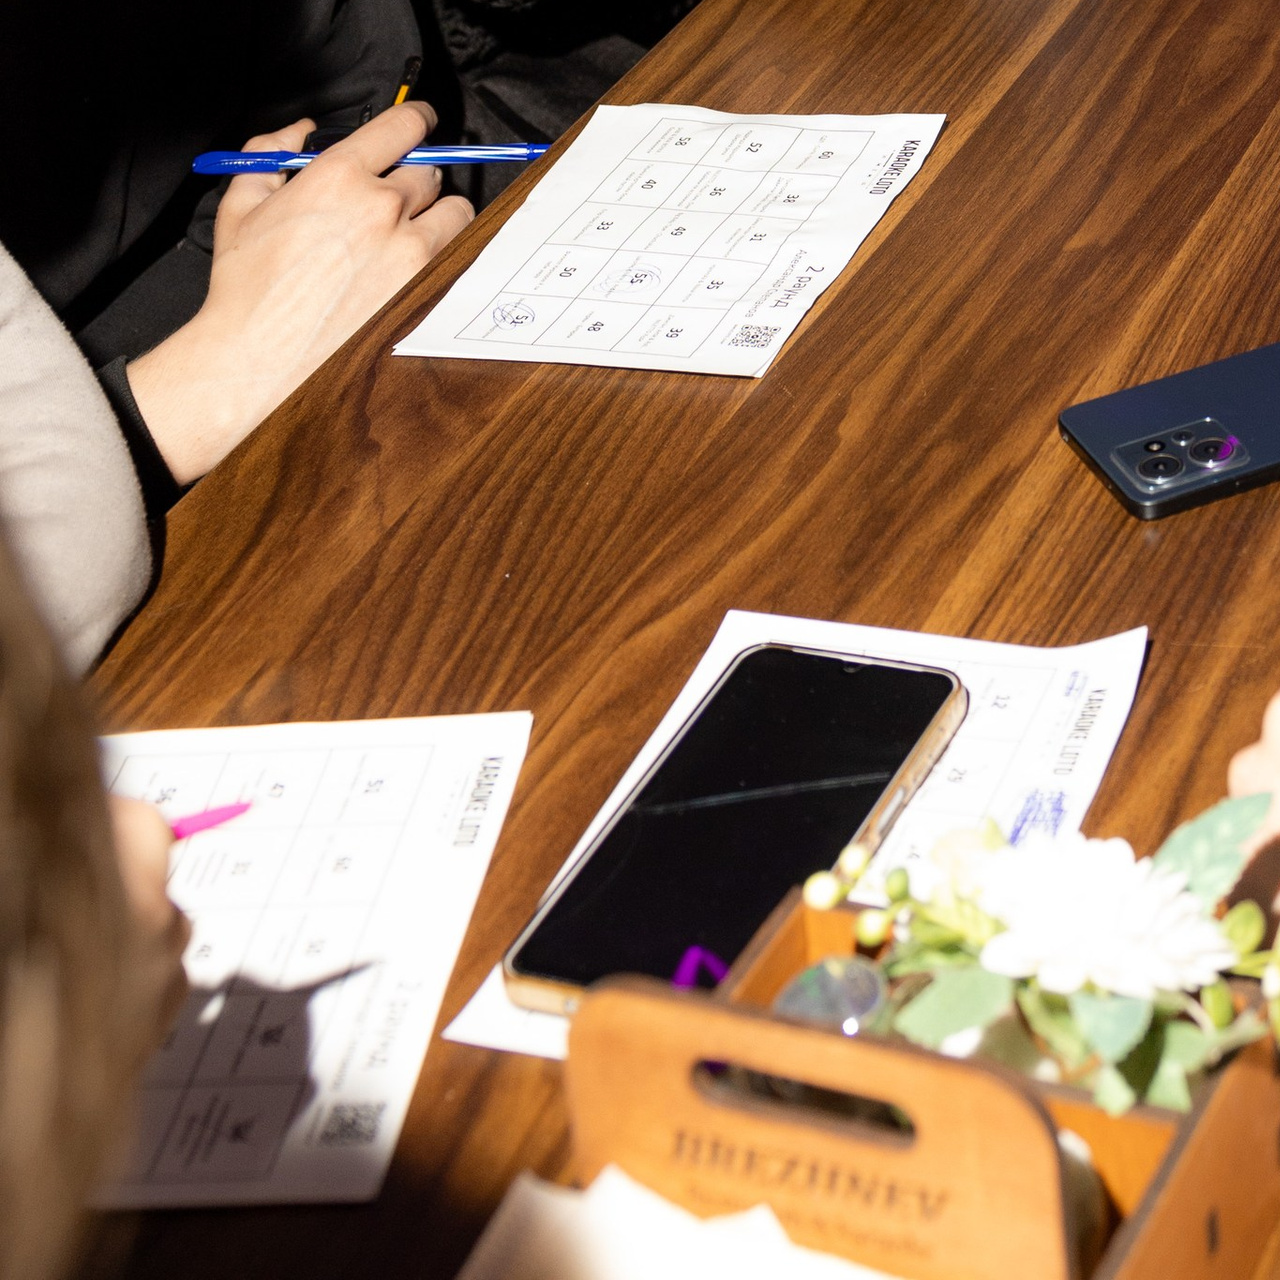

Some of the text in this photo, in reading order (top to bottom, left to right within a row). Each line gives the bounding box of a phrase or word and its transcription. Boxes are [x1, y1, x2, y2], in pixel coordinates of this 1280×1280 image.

[674, 136, 692, 147] 58
[746, 141, 762, 154] 52
[818, 150, 834, 160] 60
[883, 139, 922, 177] KARAOKE
[641, 178, 657, 190] 40
[869, 177, 897, 196] LOTO
[709, 185, 726, 197] 36
[782, 194, 800, 204] 38
[596, 219, 614, 231] 33
[670, 226, 686, 237] 49
[749, 232, 767, 242] 31
[559, 266, 577, 278] 50
[630, 272, 648, 285] 55
[706, 279, 724, 291] 35
[769, 265, 825, 309] 2 раунд
[586, 320, 604, 332] 48
[665, 327, 684, 339] 39
[1053, 688, 1107, 776] KARAOKE LOTO
